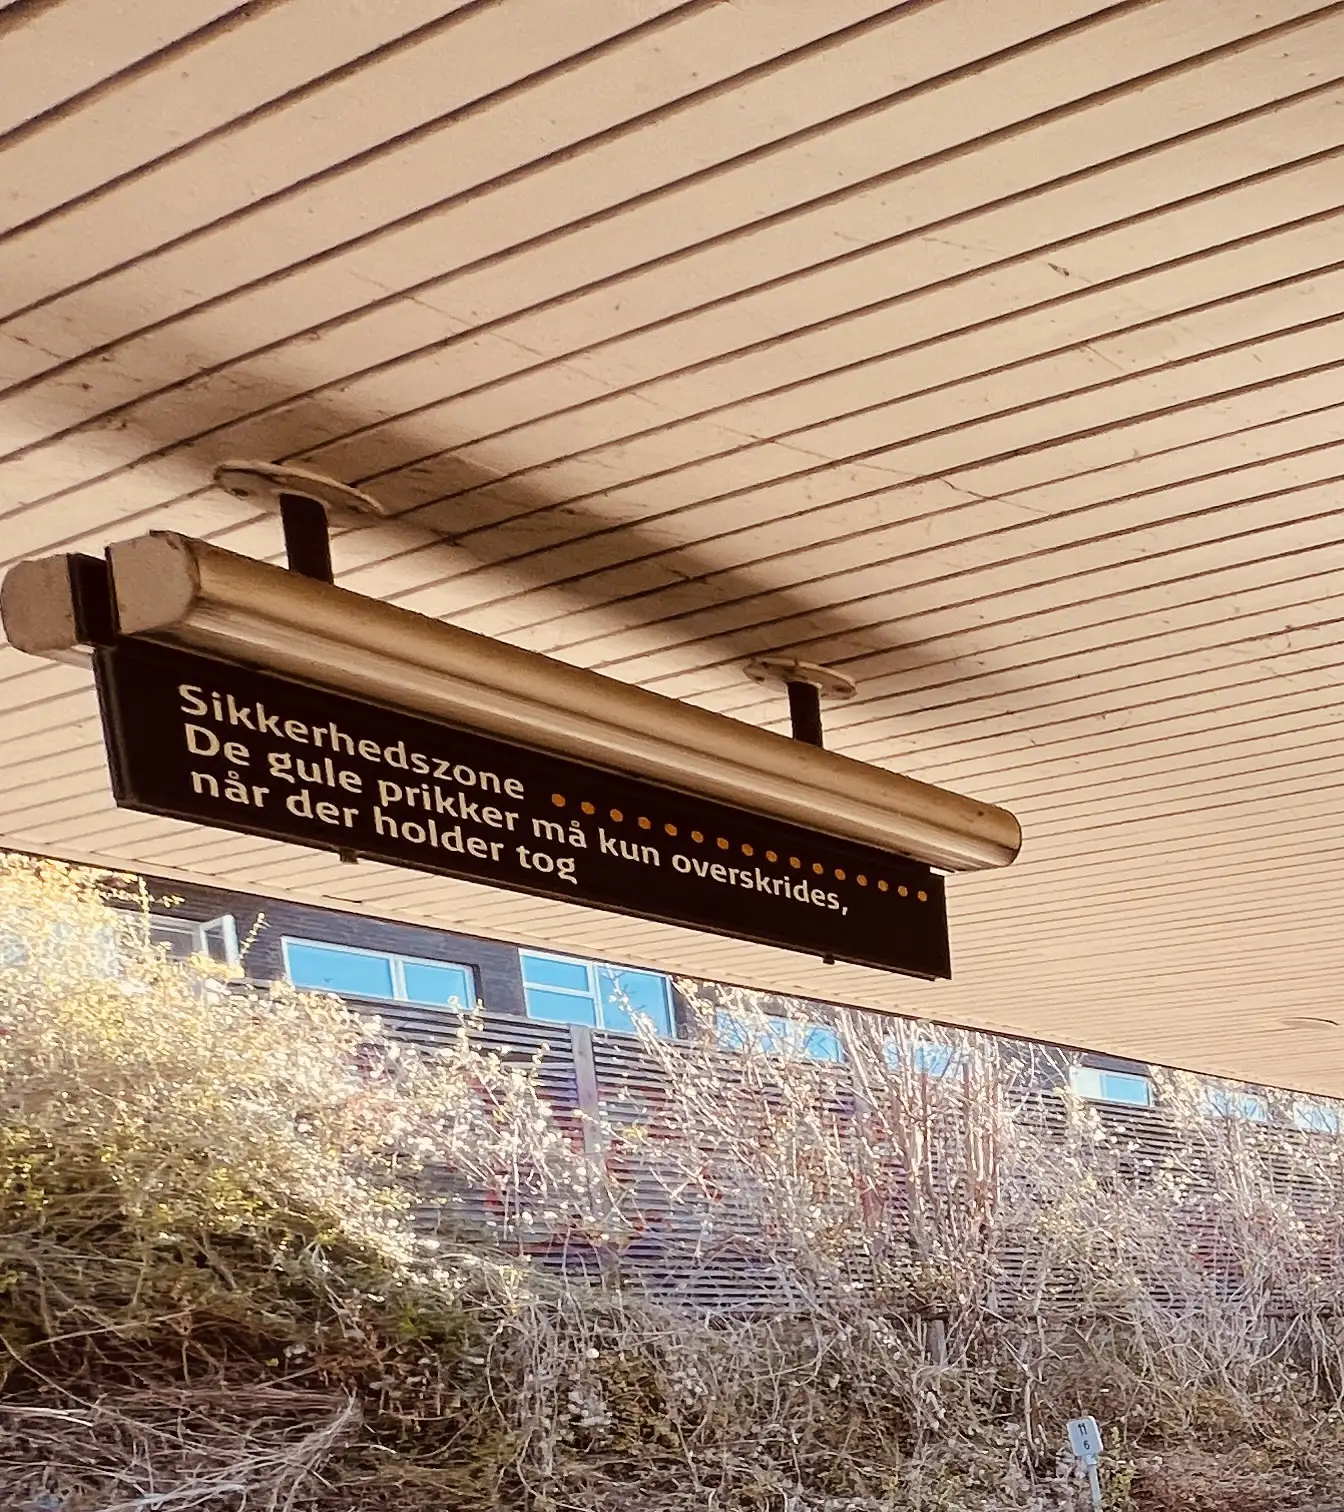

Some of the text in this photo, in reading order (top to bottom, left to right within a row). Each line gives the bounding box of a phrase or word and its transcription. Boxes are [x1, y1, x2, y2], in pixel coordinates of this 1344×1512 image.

[179, 685, 524, 799] Sikkerhedszone
[185, 723, 847, 915] De gule prikker må kun overskrides,
[191, 771, 577, 884] når der holder tog
[1077, 1422, 1088, 1436] 11
[1083, 1439, 1091, 1450] 6
